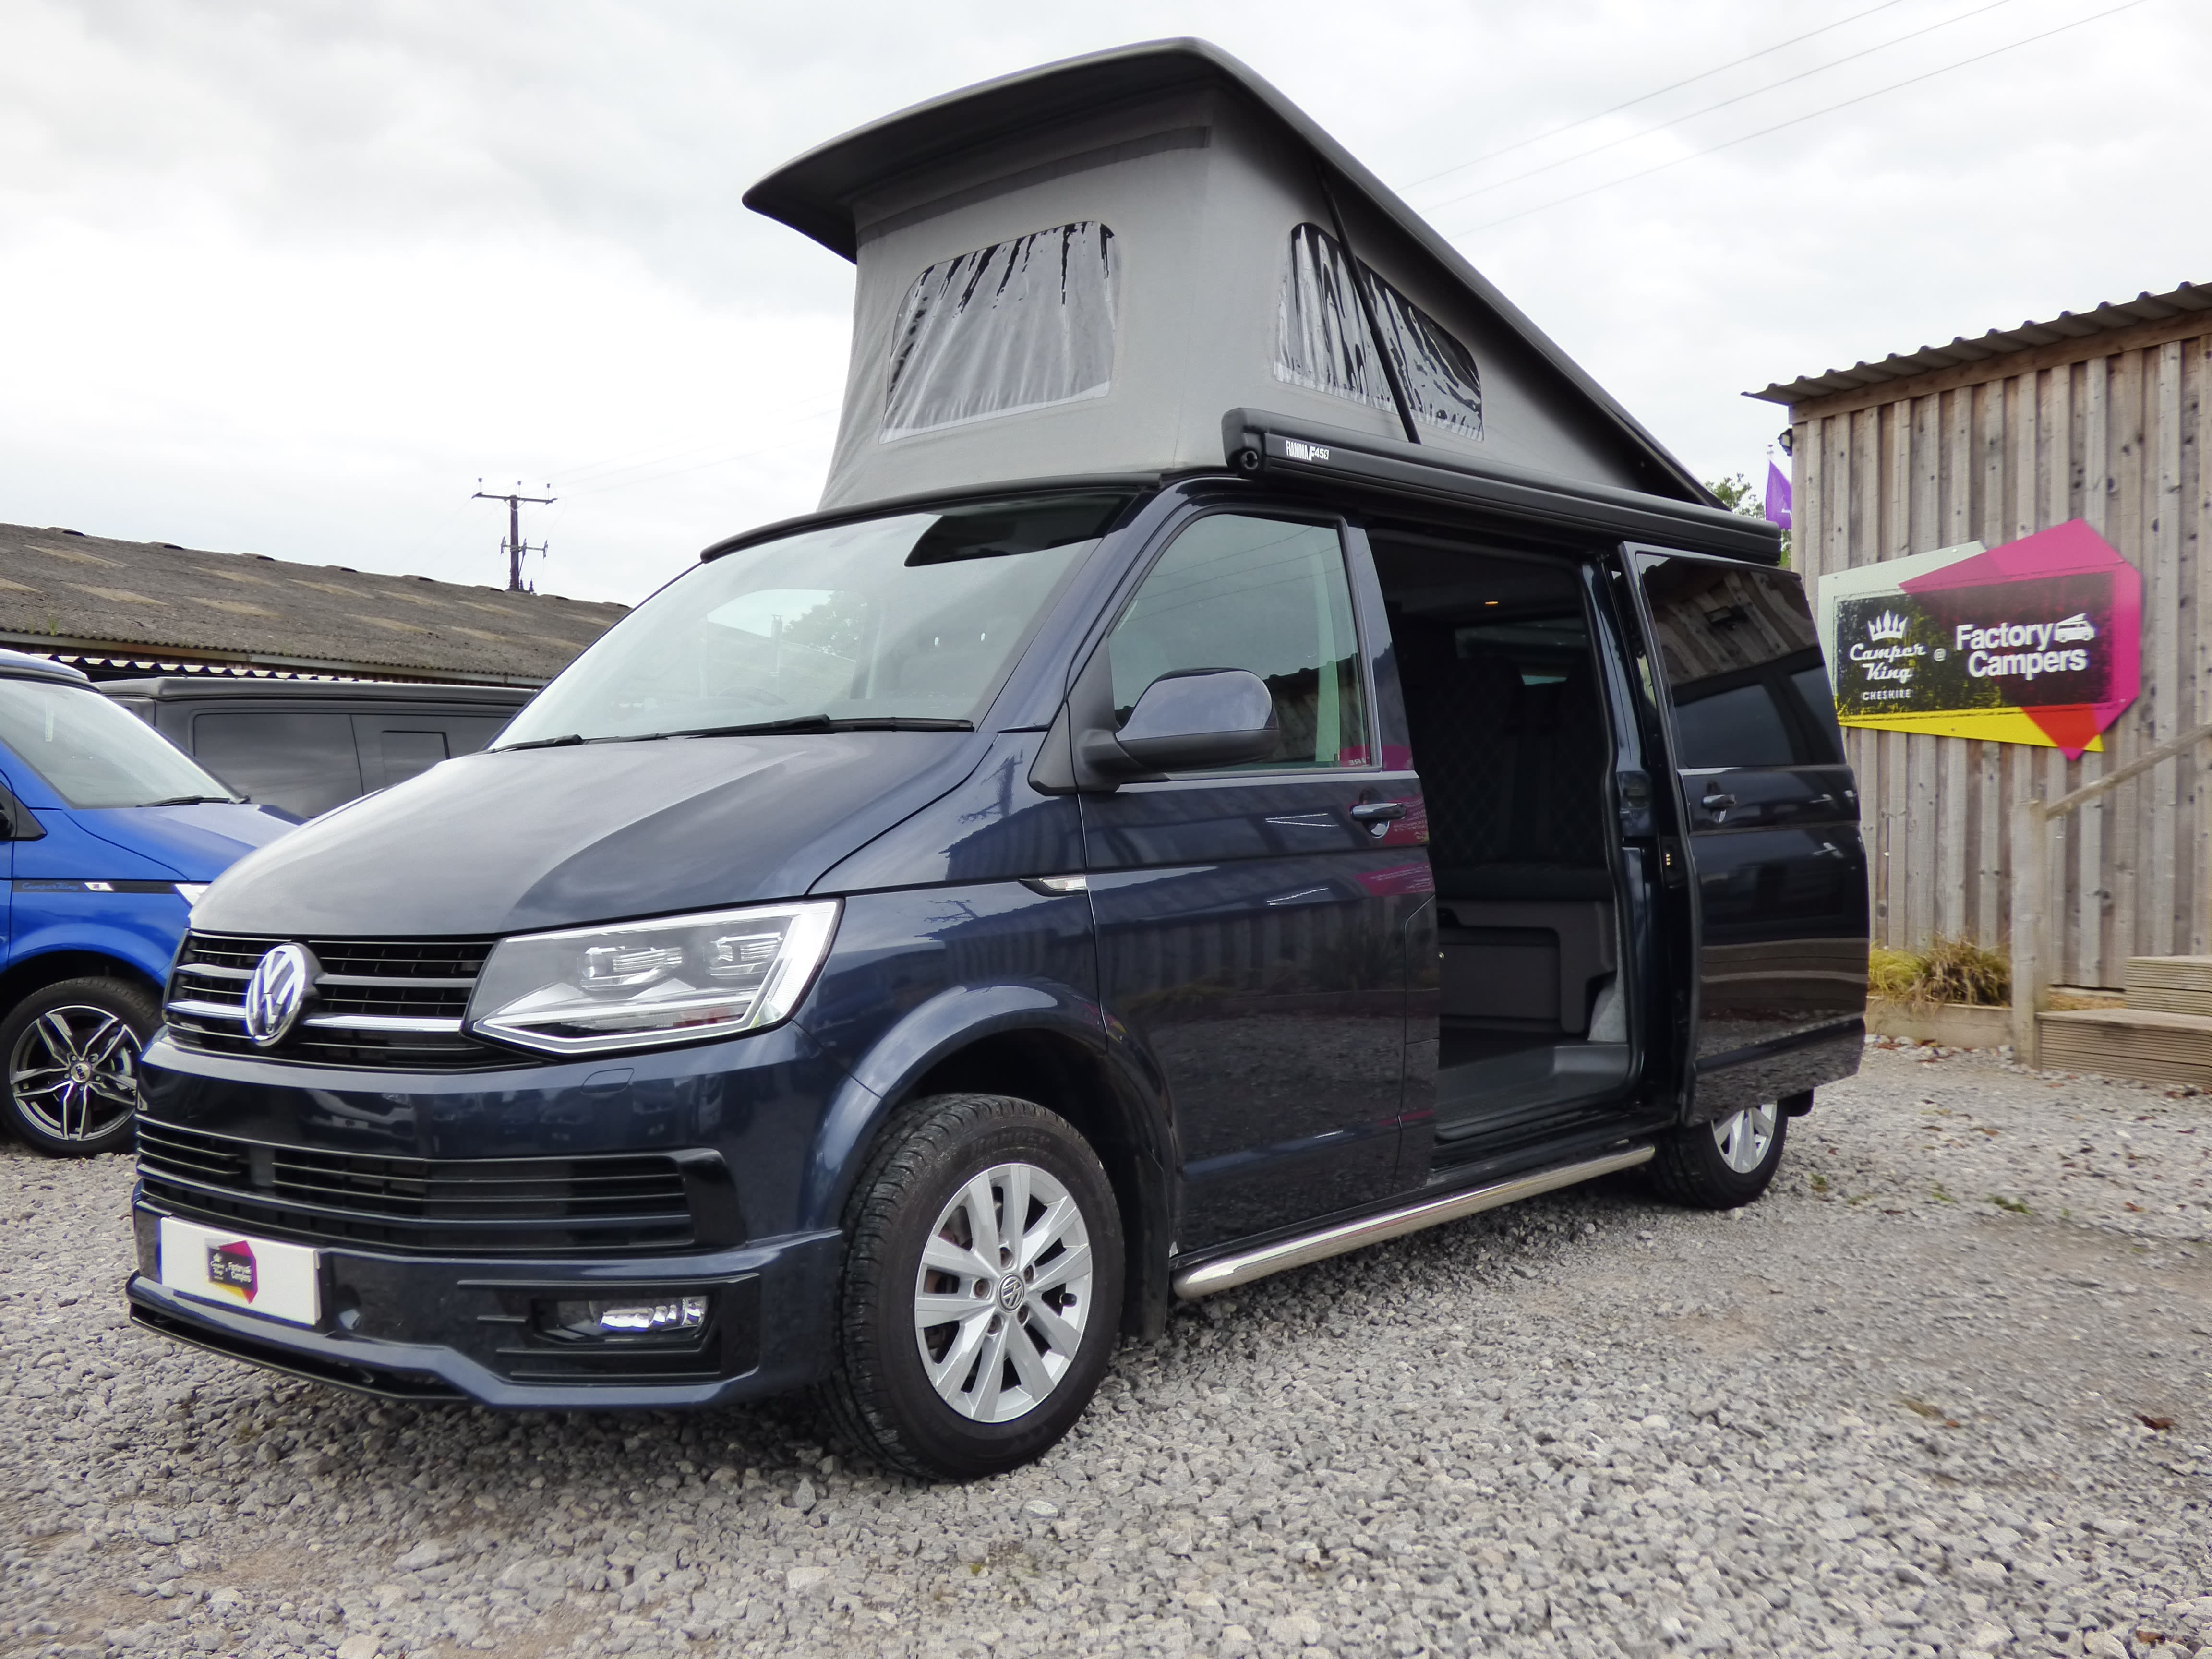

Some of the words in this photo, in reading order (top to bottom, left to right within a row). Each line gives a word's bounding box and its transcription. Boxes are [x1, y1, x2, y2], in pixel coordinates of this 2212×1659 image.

[1286, 440, 1309, 460] FIAMMA
[1956, 622, 2054, 651] Factory
[1850, 643, 1926, 663] Camper
[1862, 662, 1913, 684] King
[1969, 649, 2087, 681] Campers
[1862, 689, 1912, 700] CHESHIRE
